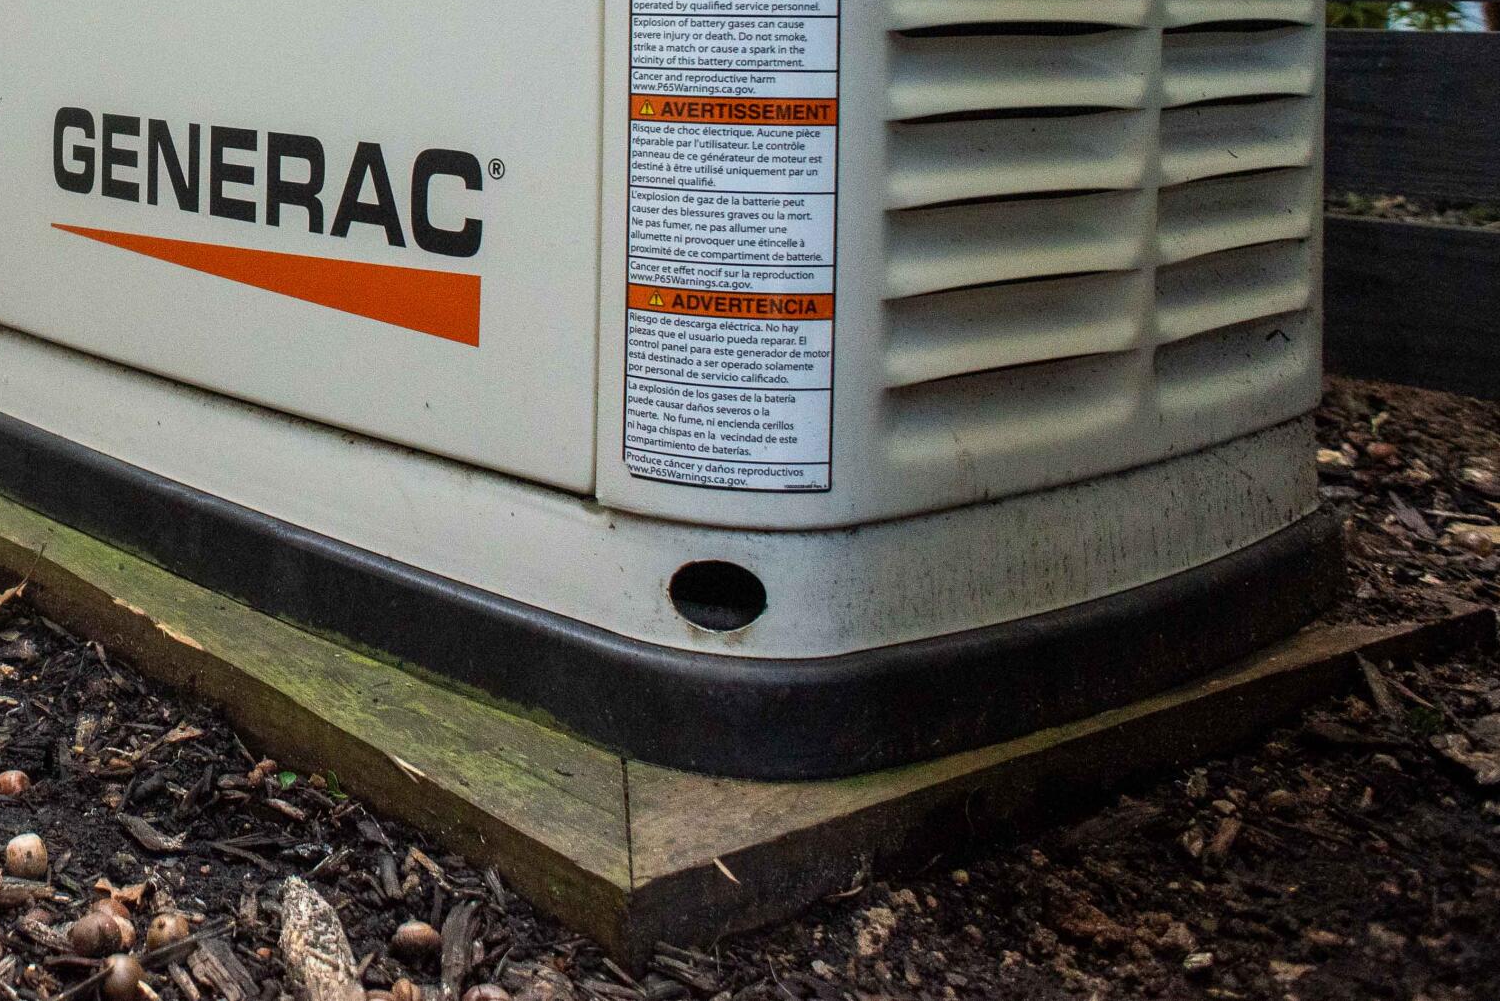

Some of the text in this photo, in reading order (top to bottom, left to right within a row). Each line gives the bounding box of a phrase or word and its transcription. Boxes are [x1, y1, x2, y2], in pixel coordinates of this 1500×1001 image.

[633, 1, 821, 13] operated by qualified service personnel.
[633, 18, 677, 29] Explosion
[677, 18, 689, 28] of
[689, 19, 727, 30] battery
[727, 21, 757, 31] gases
[633, 32, 662, 40] severe
[663, 31, 691, 42] injury
[704, 31, 737, 41] death.
[738, 32, 754, 41] Do
[755, 33, 773, 42] not
[774, 33, 808, 43] smoke,
[633, 55, 804, 69] vicinity of this battery compartment.
[633, 72, 776, 85] Cancer and reproductive harm
[661, 101, 831, 121] AVERTISSEMENT
[632, 124, 662, 135] Risque
[662, 125, 676, 134] de
[677, 126, 701, 136] choc
[756, 129, 795, 138] Aucune
[675, 140, 693, 150] par
[751, 141, 764, 150] Le
[52, 106, 483, 258] GENERAC
[631, 175, 677, 185] personnel
[681, 194, 695, 204] de
[696, 197, 715, 206] gaz
[715, 196, 730, 205] de
[731, 196, 741, 206] la
[742, 197, 782, 207] batterie
[782, 199, 805, 209] peut
[631, 205, 661, 215] causer
[661, 206, 679, 216] des
[679, 207, 726, 219] blessures
[727, 212, 760, 221] graves
[776, 211, 786, 220] la
[786, 212, 813, 221] mort.
[631, 217, 644, 226] Ne
[645, 220, 662, 229] pas
[662, 219, 693, 232] fumer,
[709, 225, 728, 234] pas
[728, 223, 767, 234] allumer
[630, 261, 661, 273] Cancer
[661, 265, 672, 274] et
[673, 265, 696, 276] effet
[697, 268, 723, 278] nocif
[741, 269, 751, 279] la
[752, 270, 815, 282] reproduction
[671, 293, 818, 315] ADVERTENCIA
[629, 312, 659, 326] Riesgo
[659, 316, 673, 326] de
[673, 317, 718, 332] descarga
[765, 323, 780, 333] No
[781, 323, 799, 335] hay
[629, 325, 807, 347] piezas que el usuario pueda reparar. El
[628, 339, 830, 359] control panel para este generador de motor
[647, 352, 695, 366] destinado
[703, 360, 720, 368] ser
[720, 361, 764, 371] operado
[764, 362, 814, 371] solamente
[628, 364, 789, 384] por personal de servicio calificado.
[628, 396, 655, 406] puede
[655, 400, 685, 410] causar
[715, 407, 752, 416] severos
[761, 407, 770, 417] la
[627, 409, 794, 431] muerte. No fume, ni encienda cerillos
[627, 435, 697, 452] compartimiento
[697, 443, 711, 453] de
[626, 451, 663, 466] Produce
[737, 467, 804, 478] reproductivos
